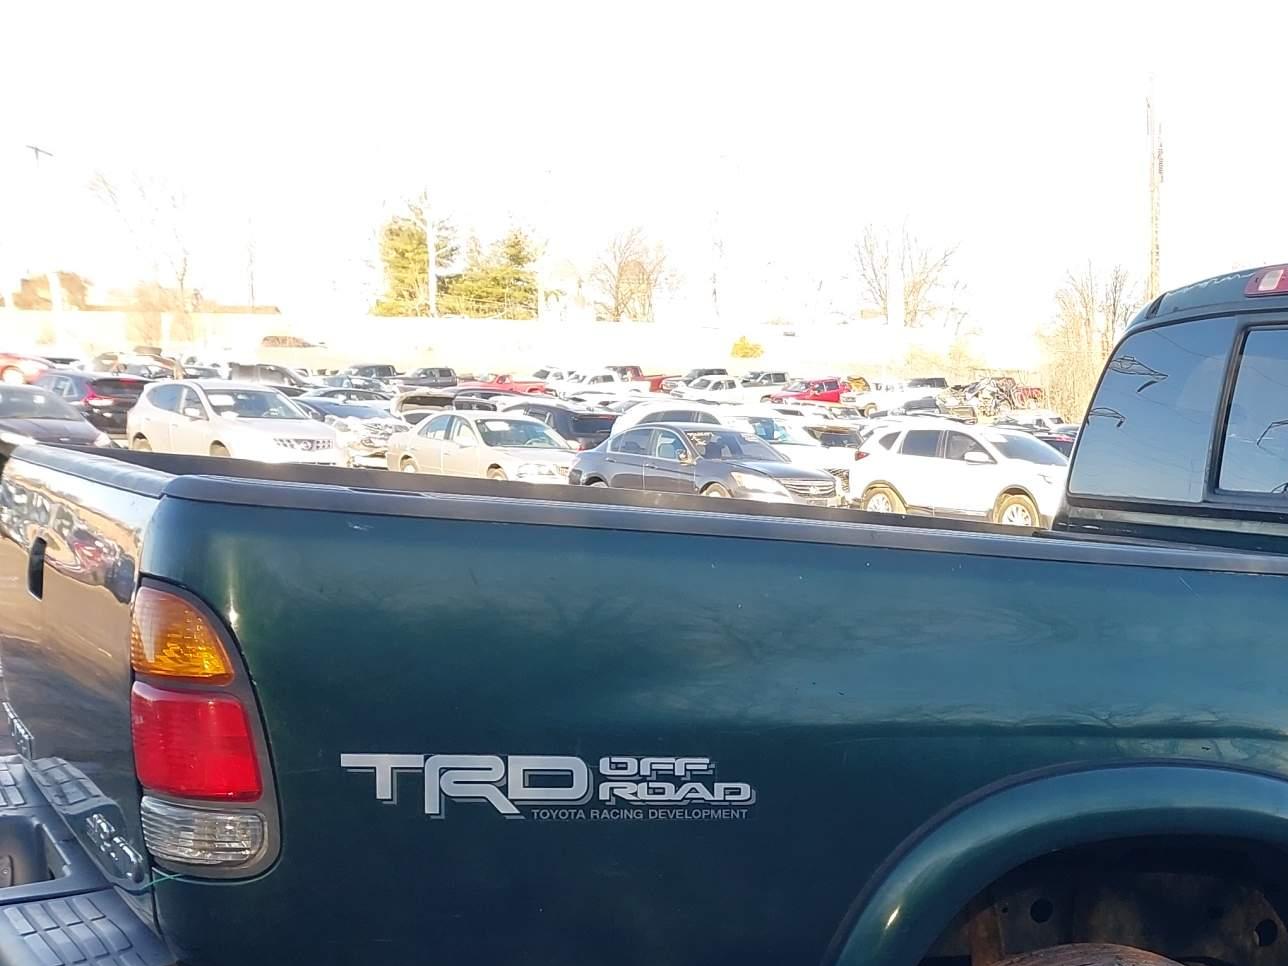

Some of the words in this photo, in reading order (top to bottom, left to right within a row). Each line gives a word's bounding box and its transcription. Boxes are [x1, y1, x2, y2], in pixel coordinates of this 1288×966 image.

[599, 757, 716, 779] OFF
[340, 753, 595, 819] TRD
[599, 782, 756, 805] ROAD
[531, 809, 586, 820] TOYOTA
[590, 809, 644, 820] RACING
[648, 809, 749, 820] DEVELOPMENT
